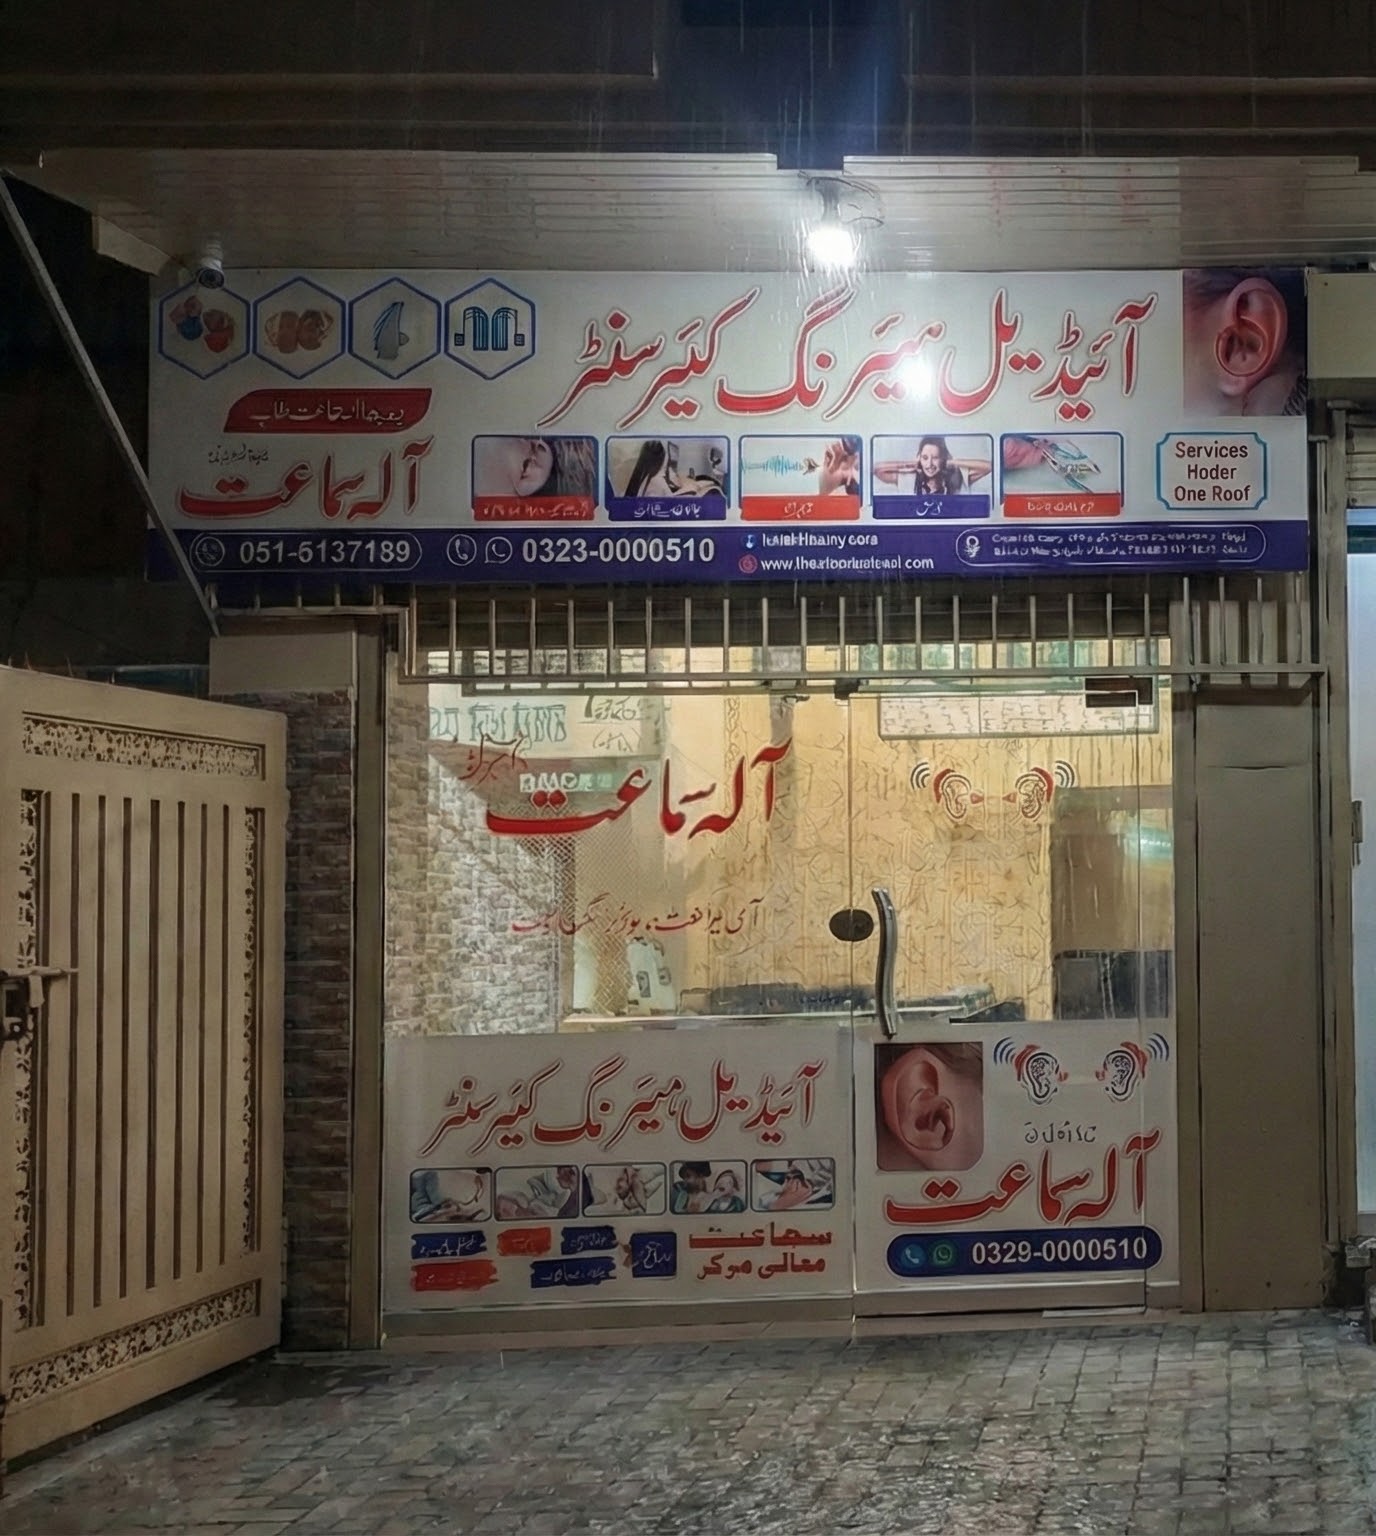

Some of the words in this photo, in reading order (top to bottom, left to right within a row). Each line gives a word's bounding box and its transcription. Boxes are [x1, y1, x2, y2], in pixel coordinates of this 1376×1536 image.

[1174, 440, 1249, 459] Services
[1186, 464, 1238, 480] Hoder
[1174, 485, 1207, 502] One
[1212, 484, 1251, 502] Roof
[522, 537, 715, 563] 0323-0000510
[971, 1237, 1148, 1265] 0329-0000510
